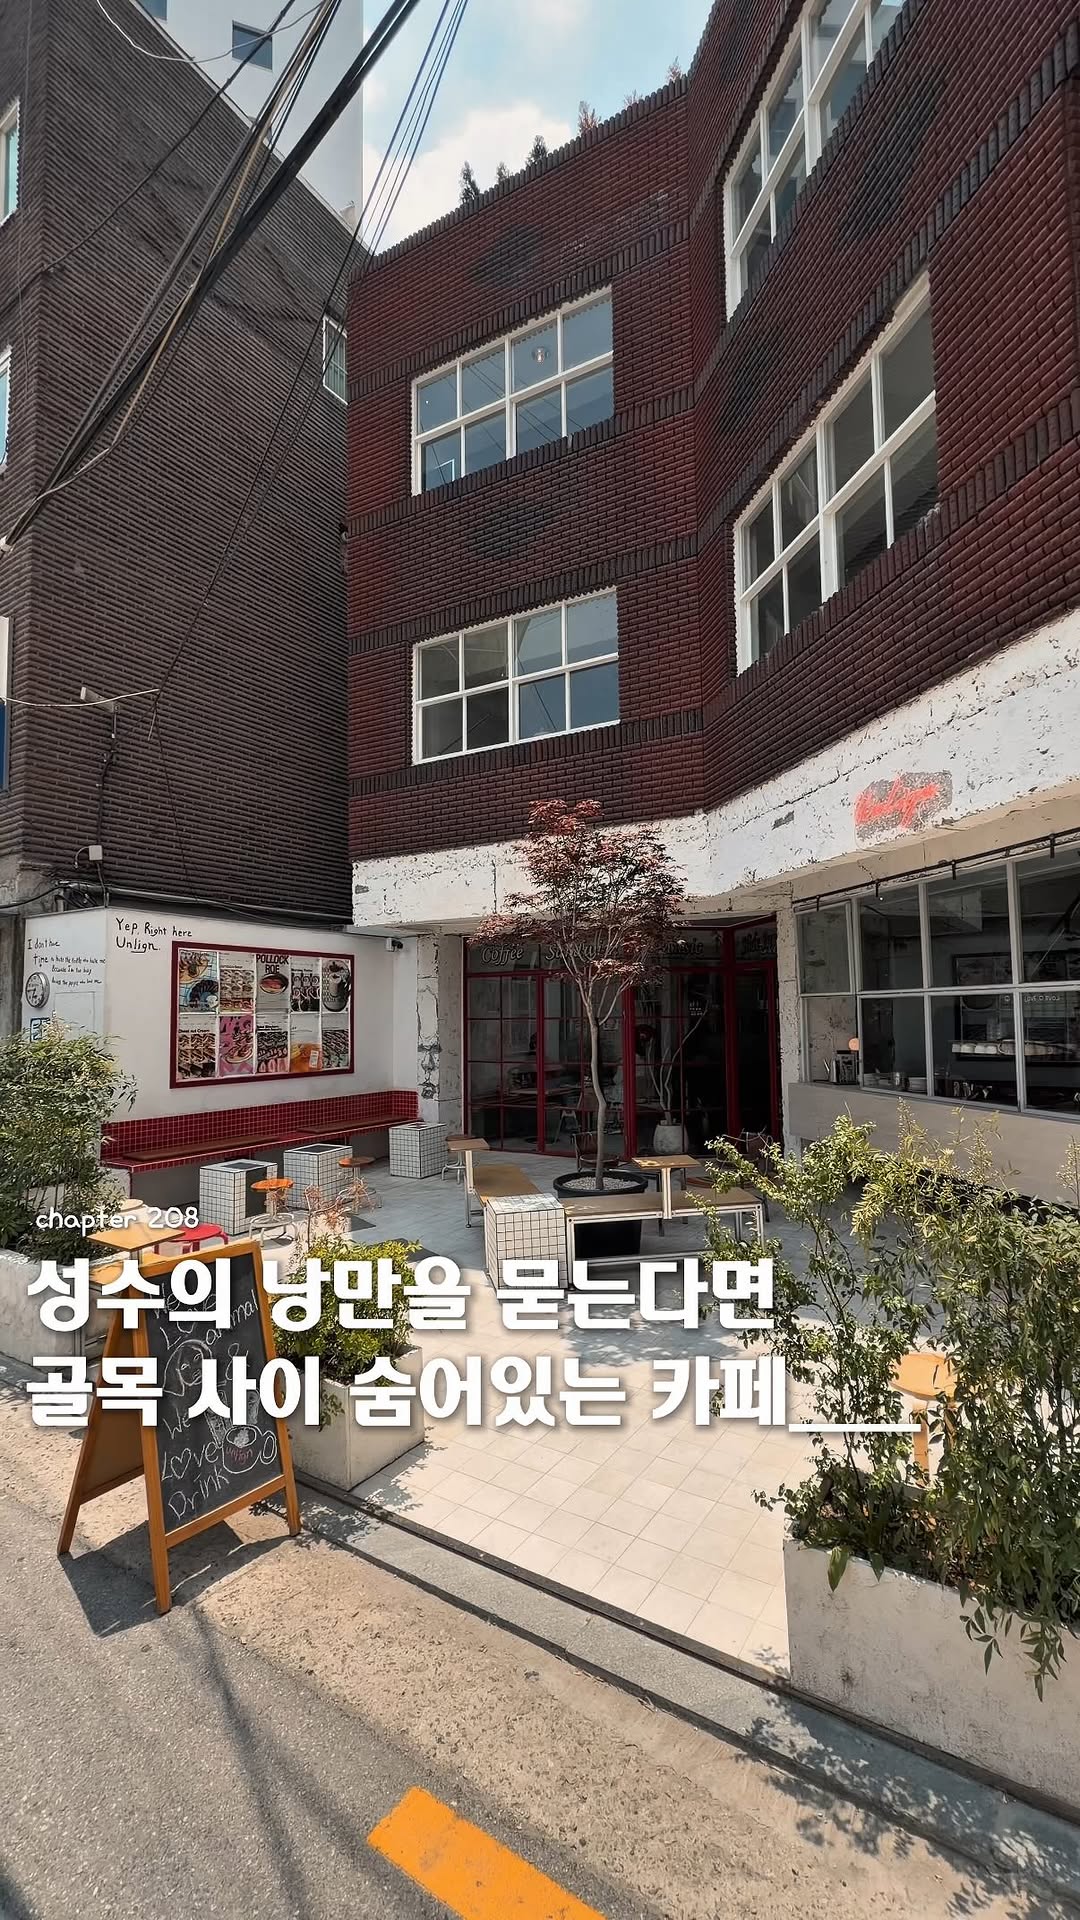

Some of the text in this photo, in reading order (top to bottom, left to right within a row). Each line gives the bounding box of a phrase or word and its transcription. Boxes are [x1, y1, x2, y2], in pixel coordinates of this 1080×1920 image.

[144, 921, 167, 937] Right
[172, 925, 193, 937] here
[27, 938, 33, 950] I
[255, 954, 290, 965] POLLOCK
[481, 943, 524, 965] Coffee
[265, 965, 280, 974] ROE
[168, 1464, 230, 1521] Drink
